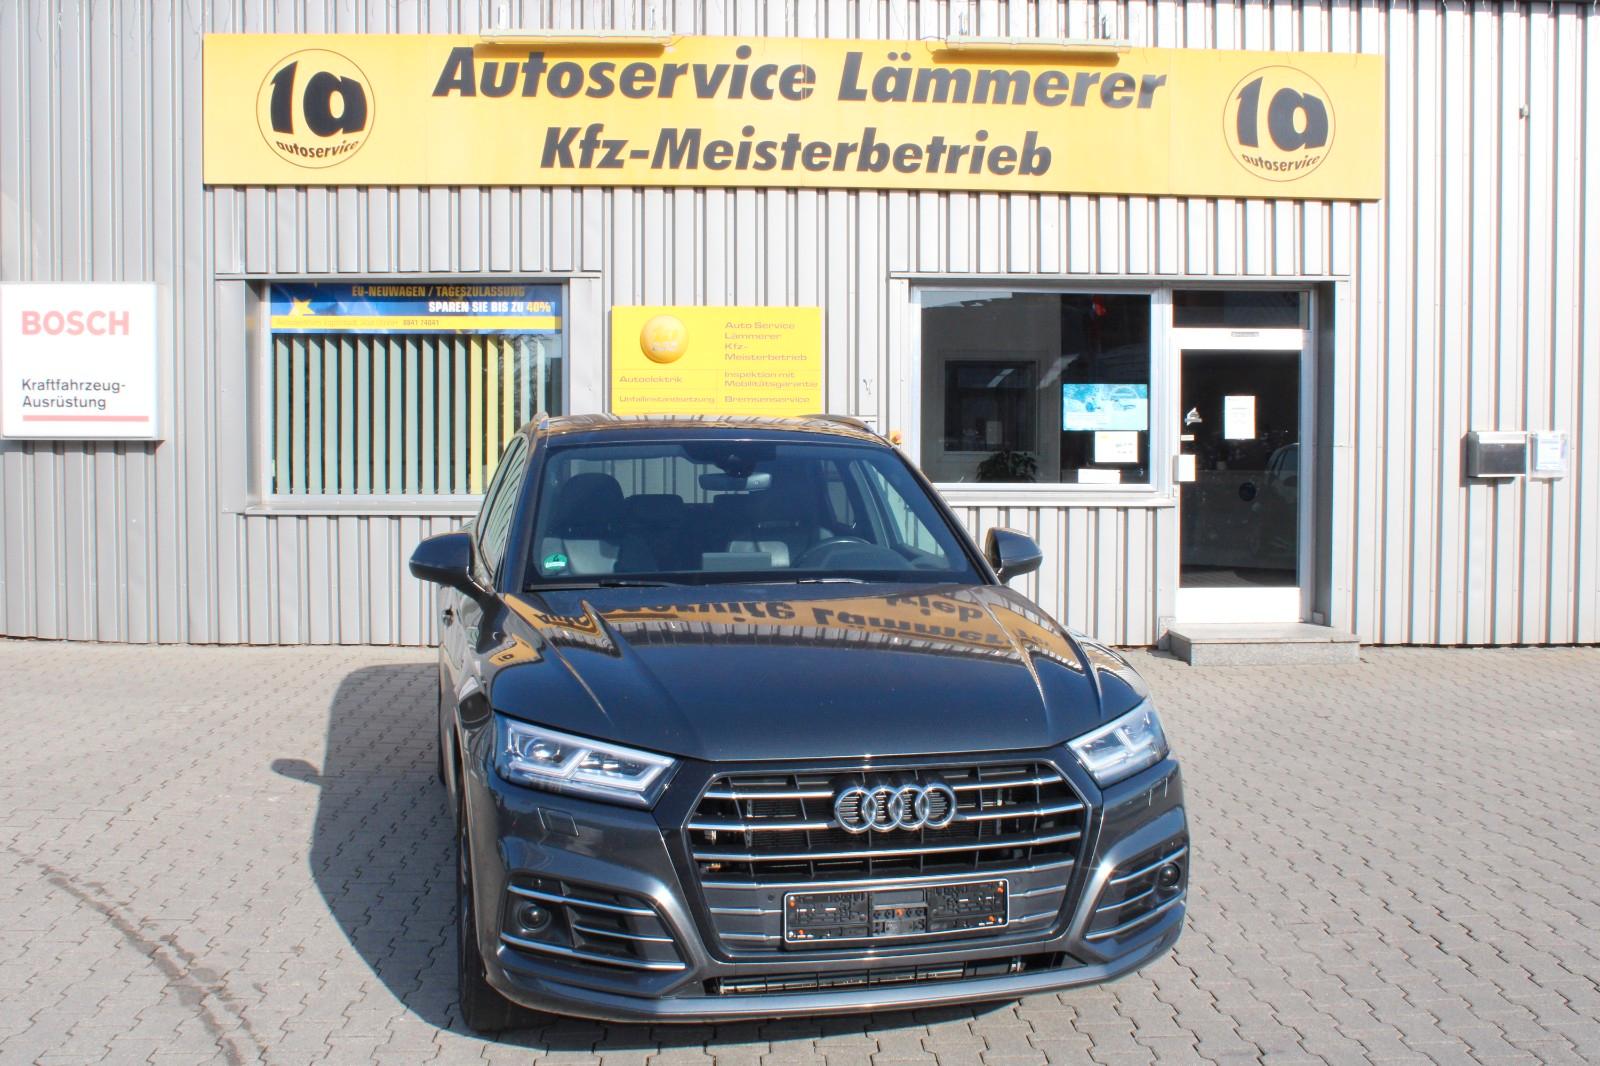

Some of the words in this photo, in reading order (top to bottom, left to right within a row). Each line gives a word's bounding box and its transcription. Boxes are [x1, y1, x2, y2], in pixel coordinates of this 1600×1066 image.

[432, 45, 816, 101] Autoservice
[837, 51, 1167, 109] Lämmerer
[270, 60, 367, 137] 1a
[1236, 76, 1329, 152] 1a
[275, 140, 359, 158] autoservice
[540, 123, 1052, 177] Kfz-Meisterbetrieb
[1241, 154, 1321, 172] autoservice
[352, 286, 426, 297] EU-NEUWAGEN
[436, 286, 525, 297] TAGESZULASSUNG
[428, 301, 469, 312] SPAREN
[471, 301, 488, 312] SIE
[491, 301, 508, 312] BIS
[511, 301, 524, 312] ZU
[527, 301, 551, 313] 40%
[22, 310, 130, 336] BOSCH
[725, 322, 753, 330] Auto
[754, 322, 796, 330] Service
[725, 332, 782, 340] Lämmerer
[725, 353, 807, 361] Meisterbetrieb
[620, 375, 683, 383] Autoelektrik
[725, 372, 776, 380] Inspektion
[22, 379, 126, 394] Kraftfahrzeug-
[23, 395, 106, 410] Ausrüstung
[725, 396, 810, 404] Bremsenservice
